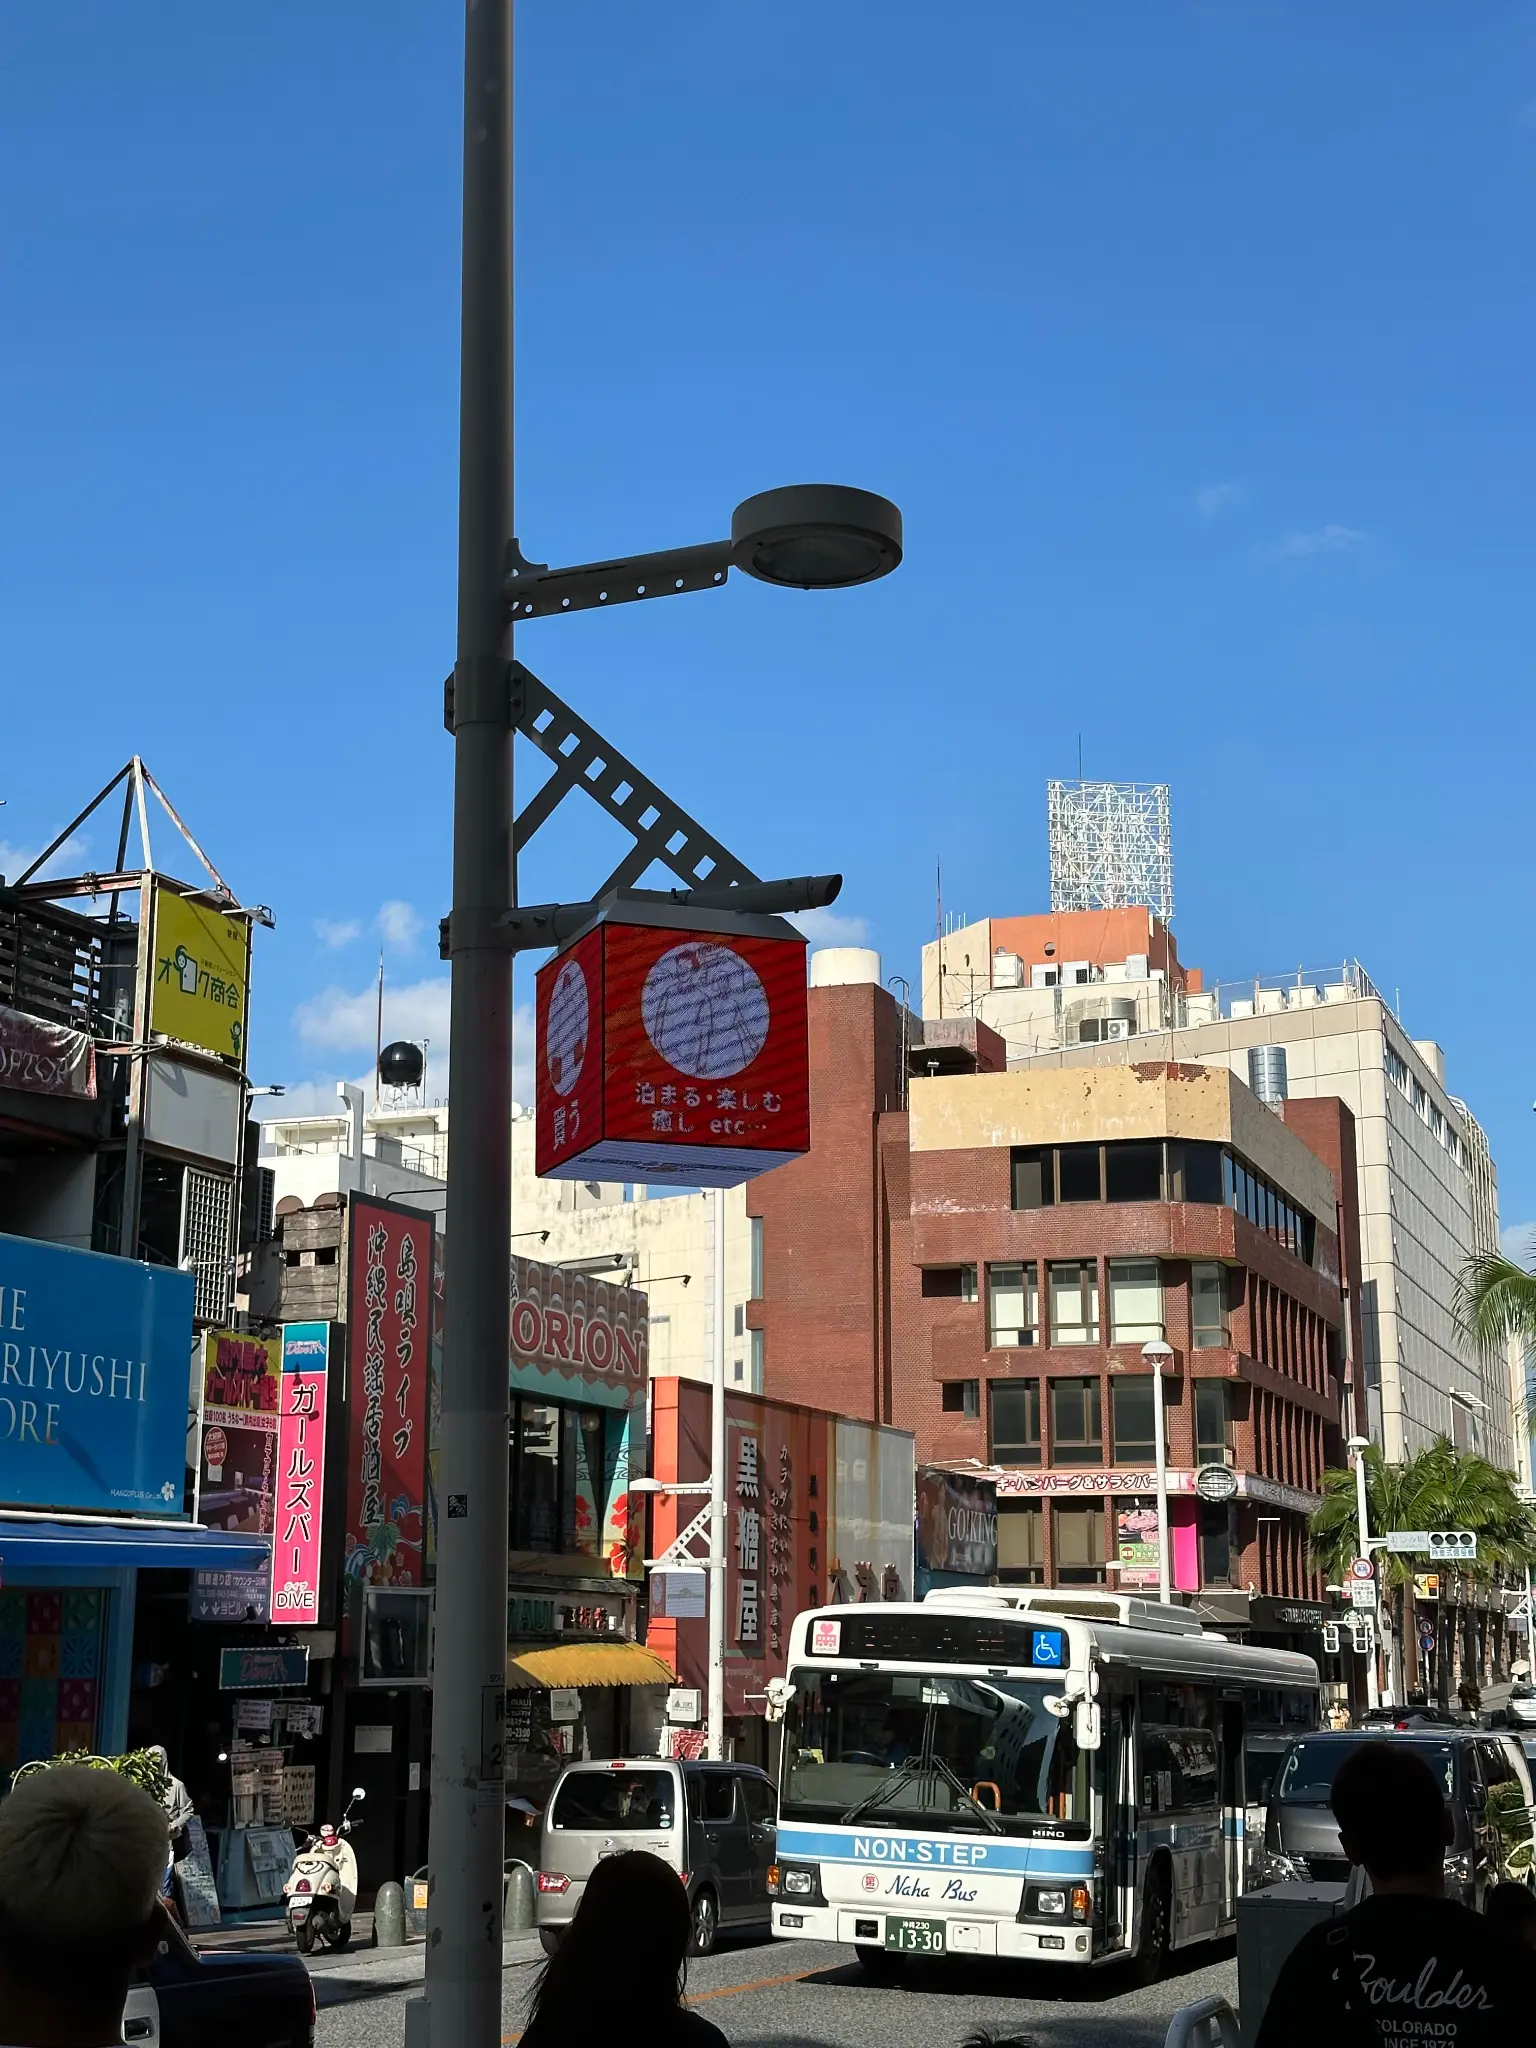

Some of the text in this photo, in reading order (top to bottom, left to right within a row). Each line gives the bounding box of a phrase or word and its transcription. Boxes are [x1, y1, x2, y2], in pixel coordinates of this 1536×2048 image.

[635, 1081, 782, 1114] 泊まる・楽しむ
[393, 1232, 418, 1460] 島唄ライブ
[510, 1300, 643, 1376] ORION
[359, 1221, 388, 1528] 沖縄民謡居酒屋
[283, 1383, 319, 1574] ガールズバー
[734, 1435, 759, 1641] 黒糖屋
[276, 1590, 315, 1610] DIVE
[1032, 1829, 1065, 1838] HINO
[853, 1837, 988, 1867] NON-STEP
[884, 1874, 978, 1902] Naha Bus
[898, 1928, 943, 1951] 13-30
[1375, 2019, 1457, 2036] OLORADO
